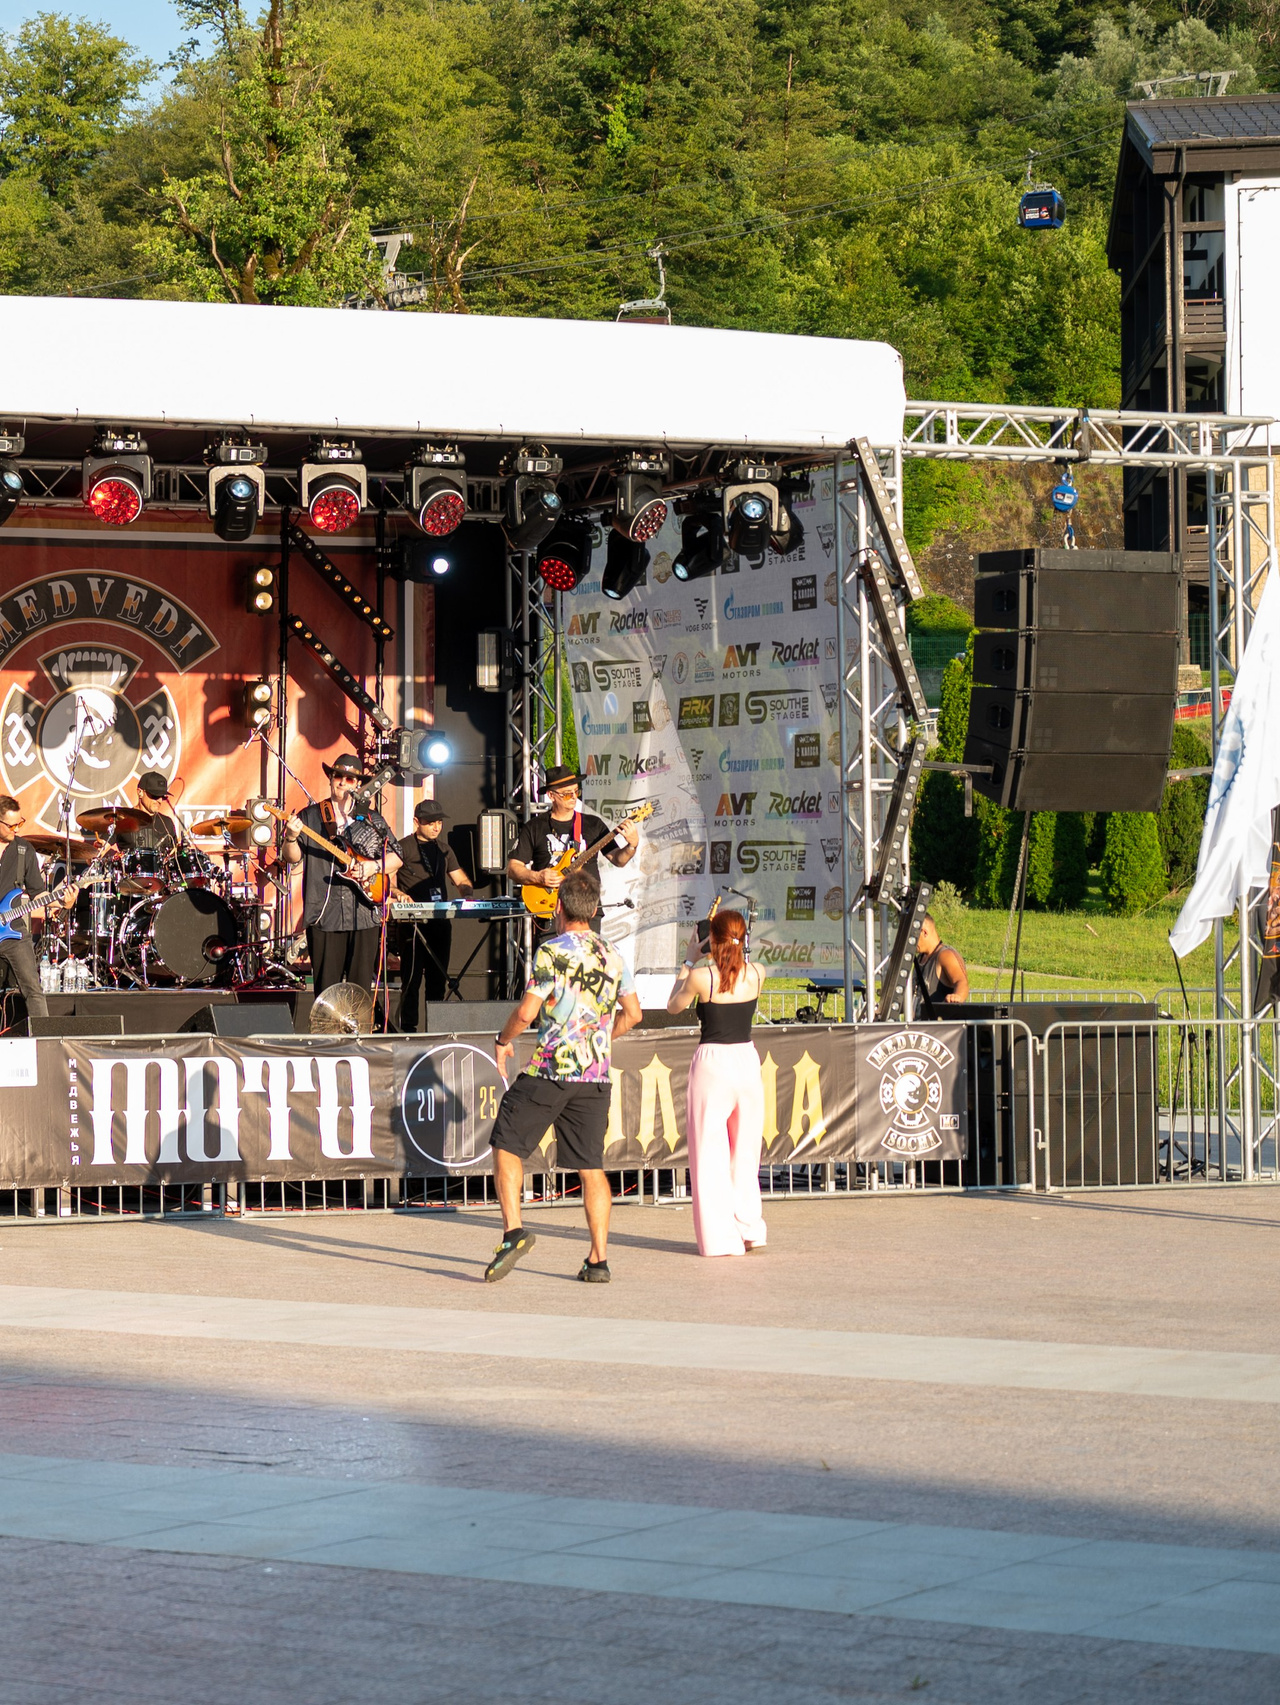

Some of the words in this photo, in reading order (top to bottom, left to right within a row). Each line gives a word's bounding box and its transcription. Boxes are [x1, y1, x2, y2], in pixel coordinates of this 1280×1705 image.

[768, 553, 798, 566] STAGE
[567, 612, 601, 636] AVT
[609, 608, 648, 633] Rocket
[568, 636, 601, 646] MOTORS
[723, 642, 761, 670] AVT
[772, 637, 820, 666] Rocket
[611, 667, 635, 680] SOUTH
[722, 669, 761, 680] MOTORS
[614, 679, 635, 689] STAGE
[681, 698, 713, 716] PRK
[770, 698, 801, 711] SOUTH
[801, 696, 809, 719] PRO
[770, 711, 801, 721] STAGE
[586, 754, 612, 776] AVT
[585, 778, 612, 786] MOTORS
[715, 791, 758, 817] AVT
[768, 790, 822, 817] Rocket
[714, 818, 756, 828] MOTORS
[762, 849, 798, 862] SOUTH
[797, 849, 806, 871] PRO
[763, 862, 796, 872] STAGE
[758, 938, 816, 965] Rocket
[570, 962, 614, 997] ART
[871, 1034, 949, 1066] MEDVEDI
[68, 1058, 80, 1166] МЕДВЕЖЬЯ
[417, 1088, 435, 1122] 20
[478, 1085, 498, 1120] 25
[941, 1116, 958, 1128] MC
[887, 1132, 937, 1151] SOCHI
